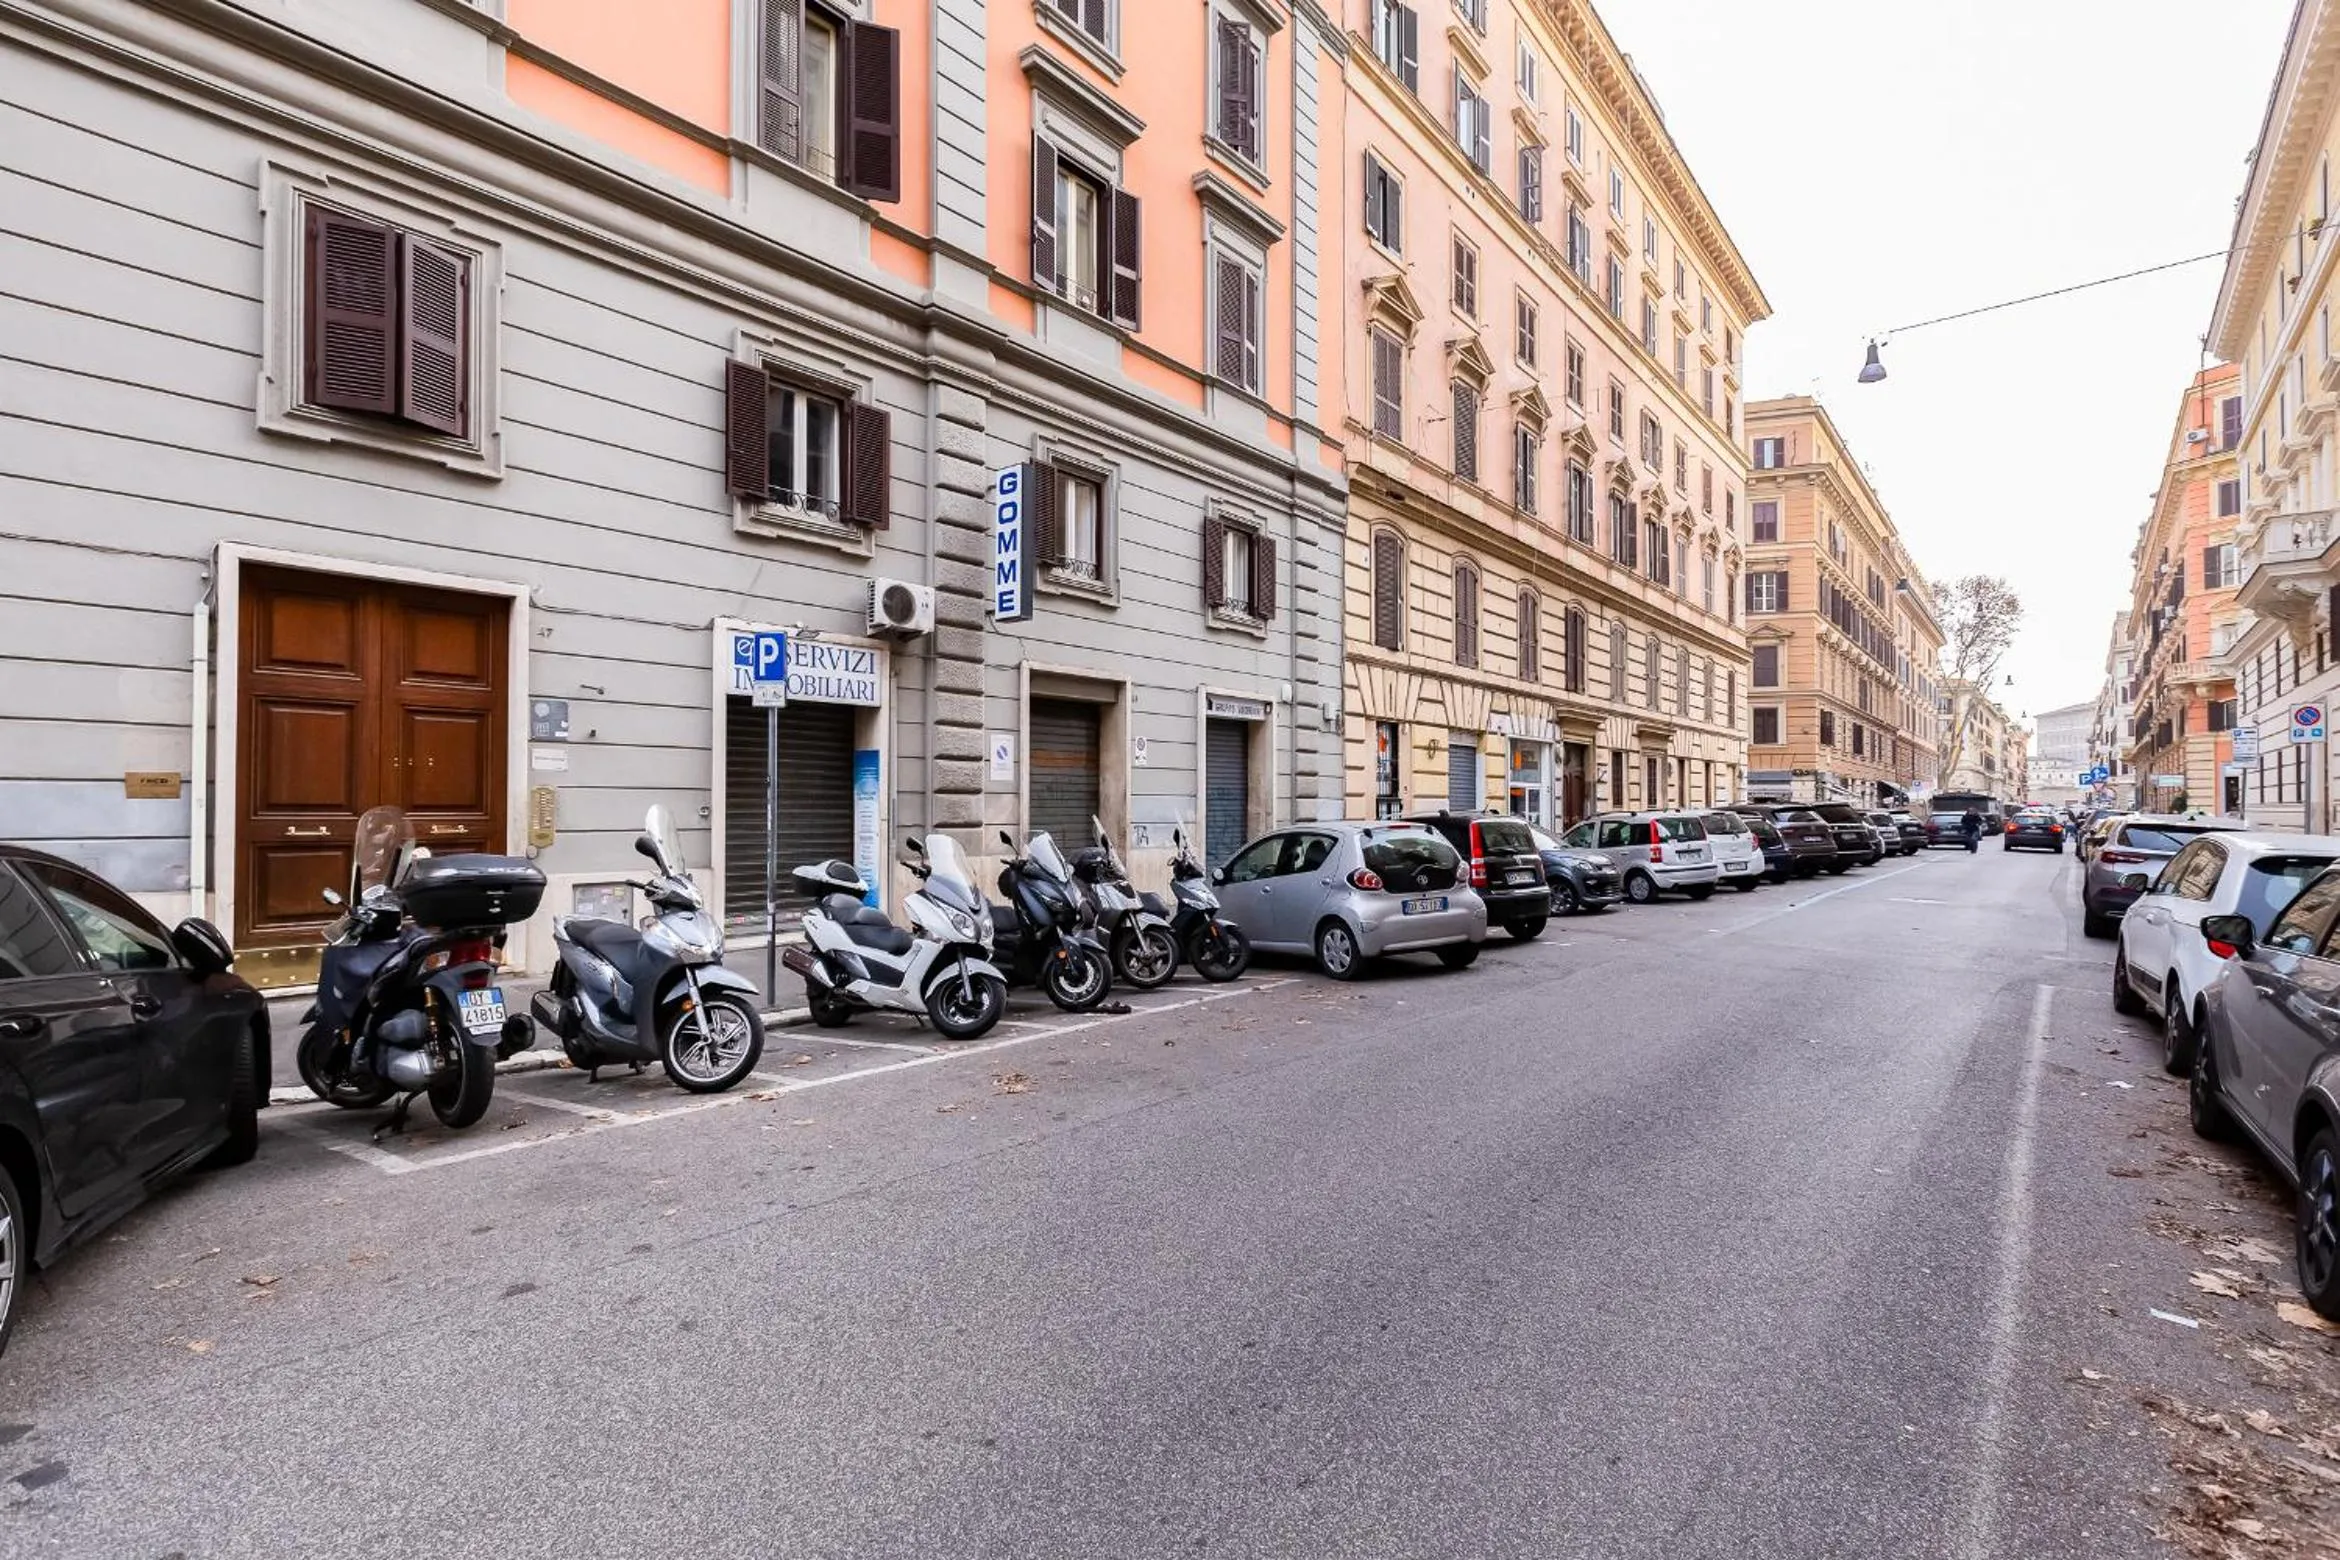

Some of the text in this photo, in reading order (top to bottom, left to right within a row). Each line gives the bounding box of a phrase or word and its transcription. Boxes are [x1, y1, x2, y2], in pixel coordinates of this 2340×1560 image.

[997, 471, 1018, 613] GOMME
[759, 637, 779, 677] P
[465, 1005, 504, 1023] 41815
